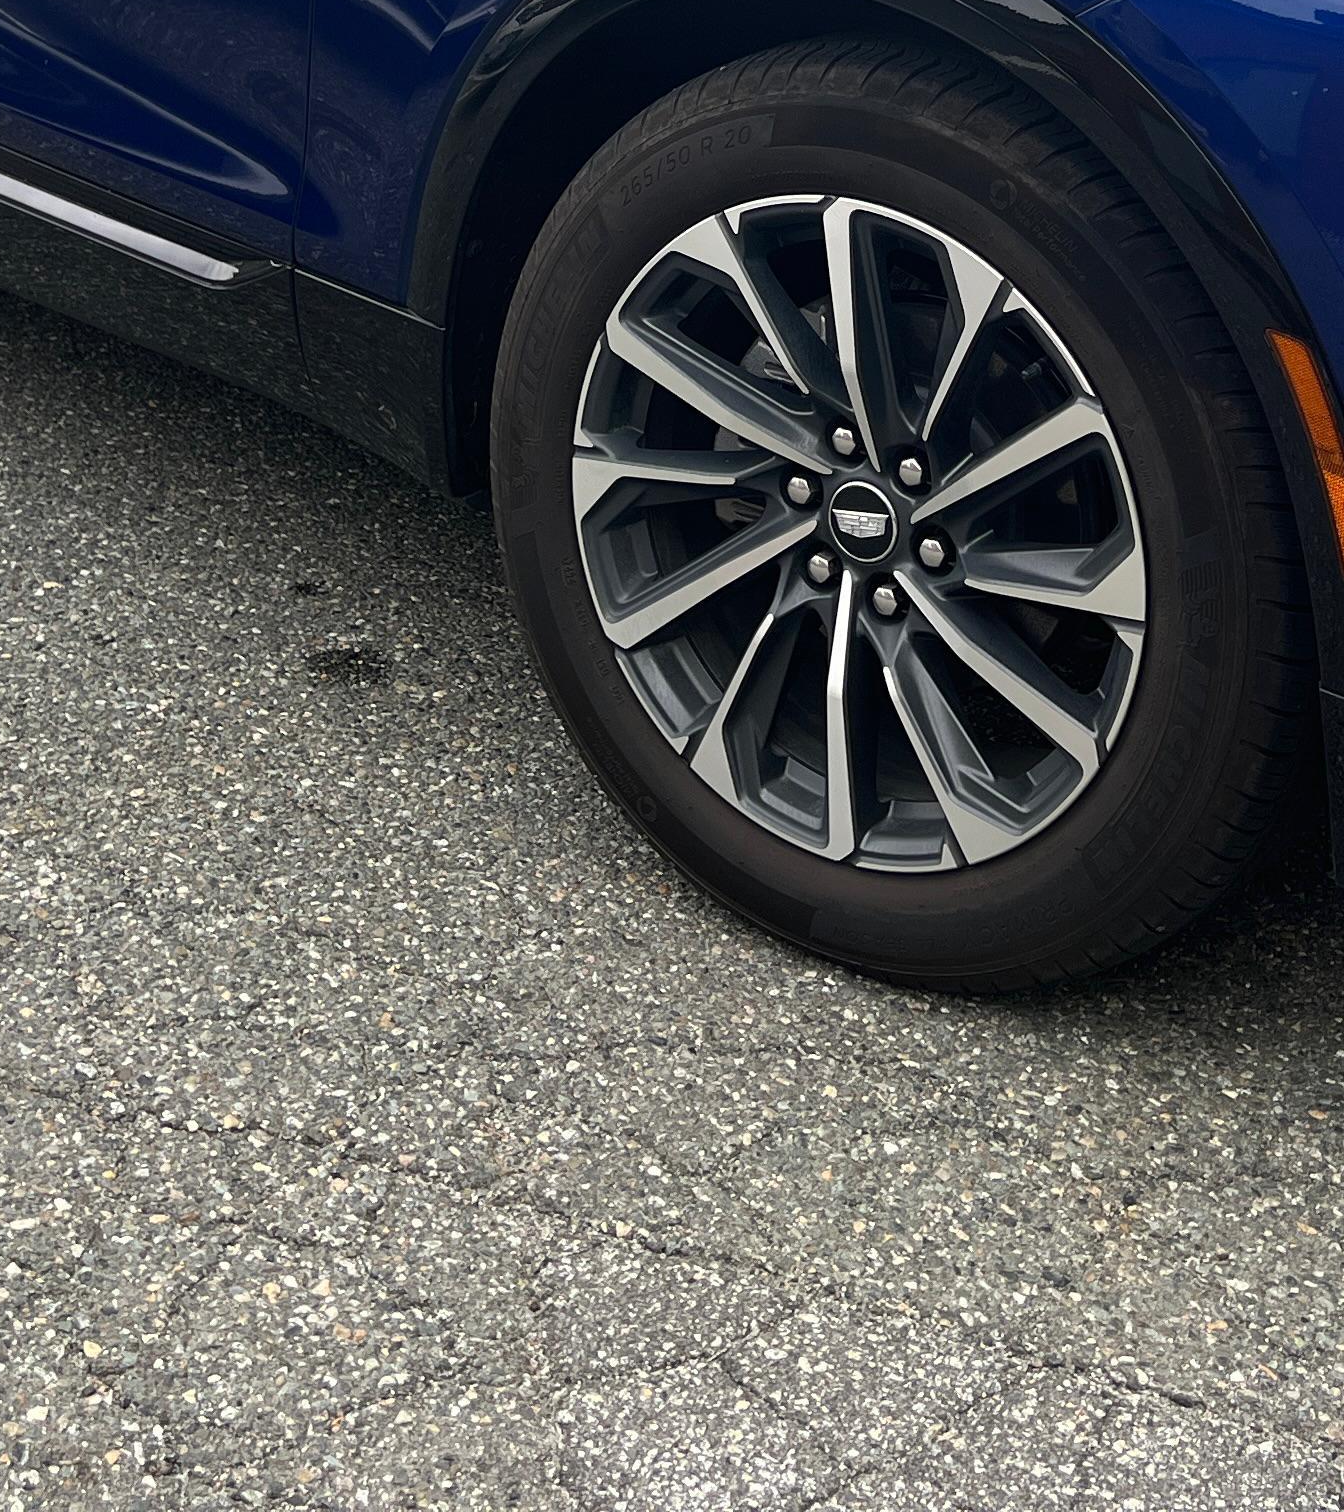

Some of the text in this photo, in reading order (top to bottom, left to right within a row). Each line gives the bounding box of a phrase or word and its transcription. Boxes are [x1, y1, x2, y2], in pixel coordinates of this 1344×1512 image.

[619, 124, 753, 208] 265/50 R 20
